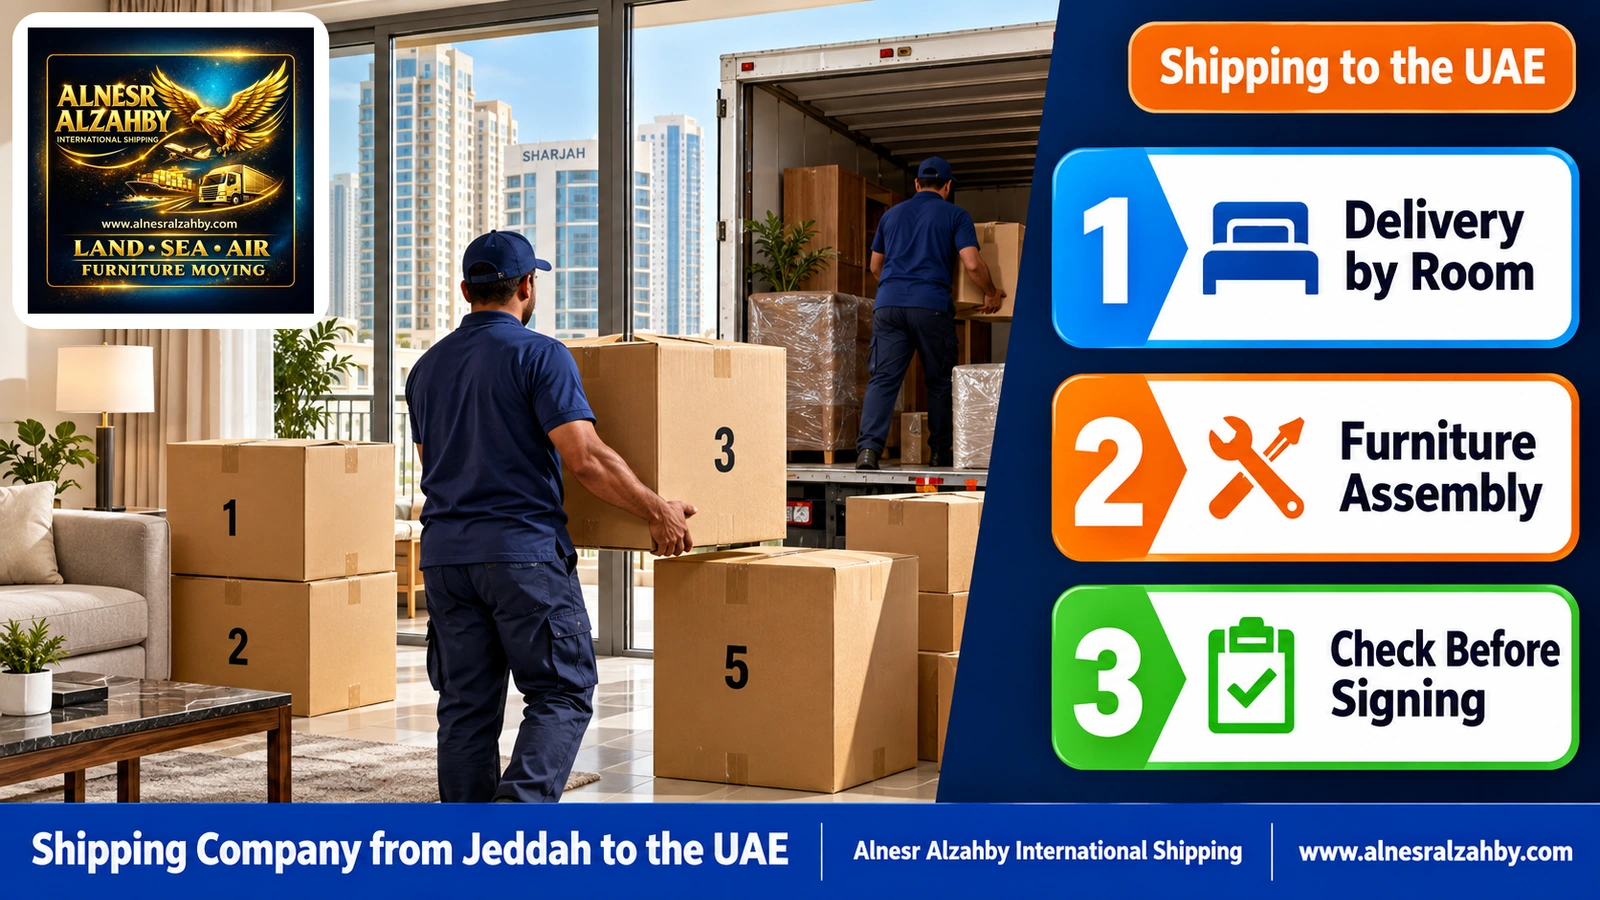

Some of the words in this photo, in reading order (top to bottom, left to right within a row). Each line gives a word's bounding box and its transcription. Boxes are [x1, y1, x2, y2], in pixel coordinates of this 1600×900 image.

[522, 147, 586, 162] SHARJAH
[713, 426, 736, 473] 3
[222, 498, 237, 537] 1
[228, 627, 249, 665] 2
[724, 644, 749, 690] 5
